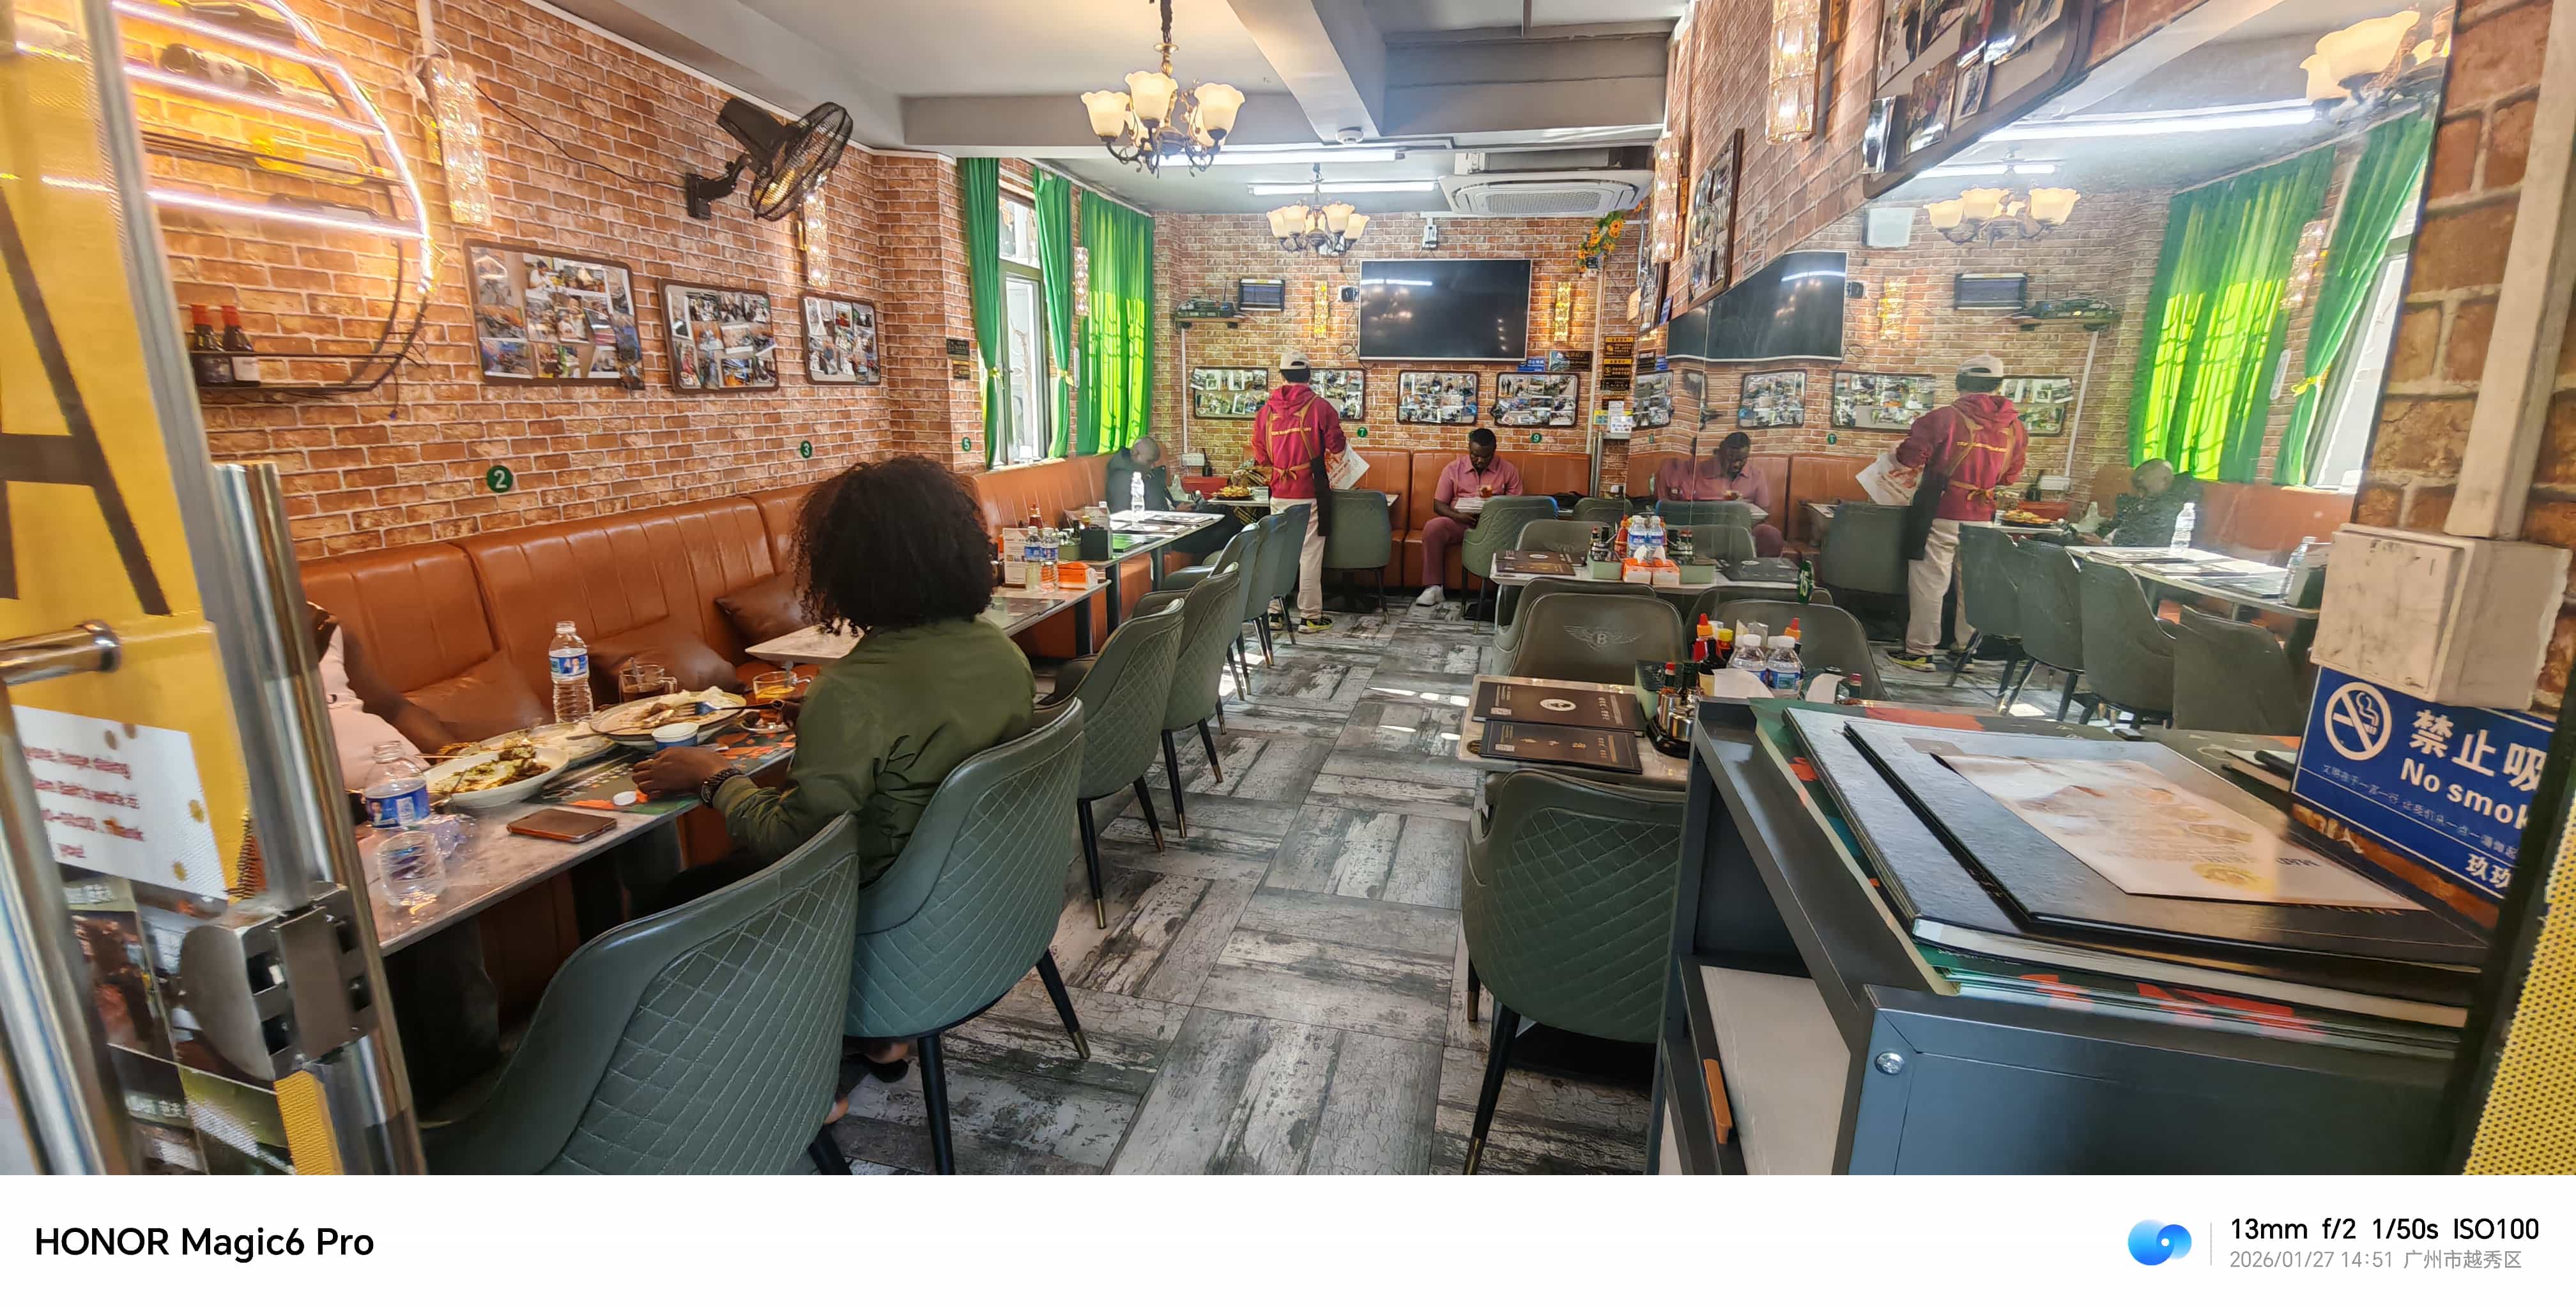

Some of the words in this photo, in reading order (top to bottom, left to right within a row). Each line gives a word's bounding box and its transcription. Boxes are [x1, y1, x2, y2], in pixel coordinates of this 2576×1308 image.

[804, 443, 810, 455] 3
[964, 438, 970, 450] 5
[494, 469, 507, 489] 2
[2409, 709, 2547, 792] 禁止吸
[2400, 757, 2441, 793] No
